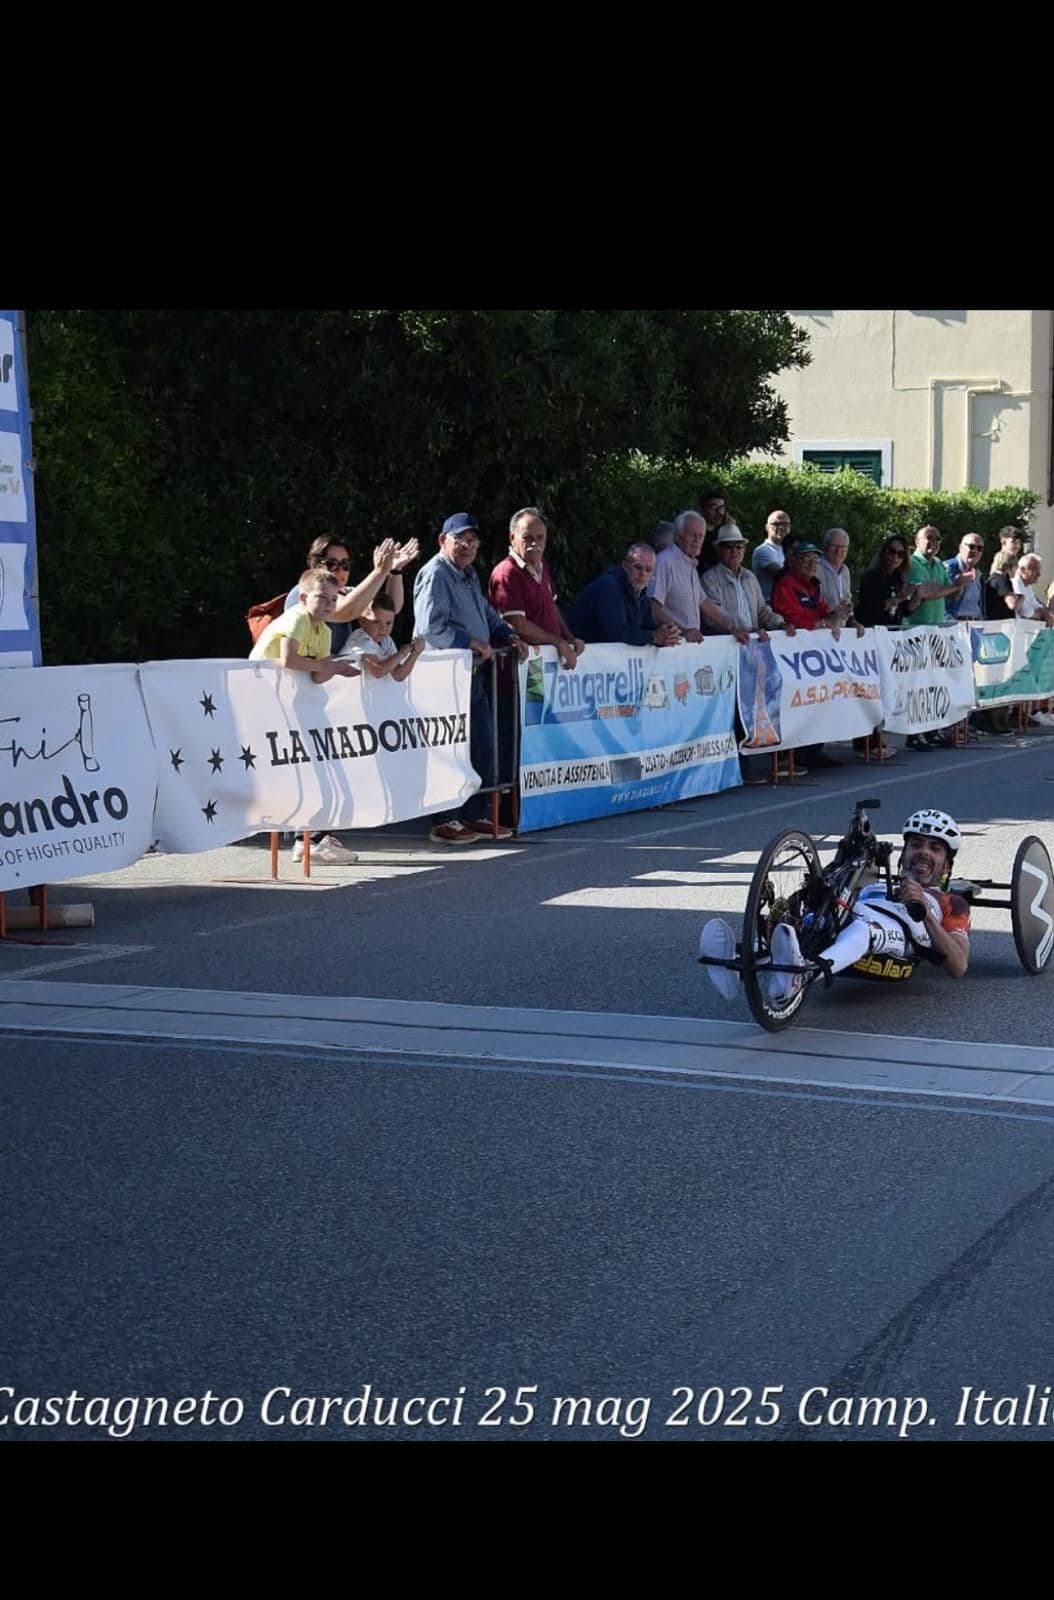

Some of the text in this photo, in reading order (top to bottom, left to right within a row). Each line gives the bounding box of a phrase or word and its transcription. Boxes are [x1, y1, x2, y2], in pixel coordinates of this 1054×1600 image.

[266, 713, 467, 766] LA MADONNINA
[523, 767, 556, 790] VENDITA
[563, 761, 609, 785] ASSISTENZA
[4, 848, 23, 865] OF
[27, 840, 70, 861] HIGHT
[73, 832, 126, 853] QUALITY
